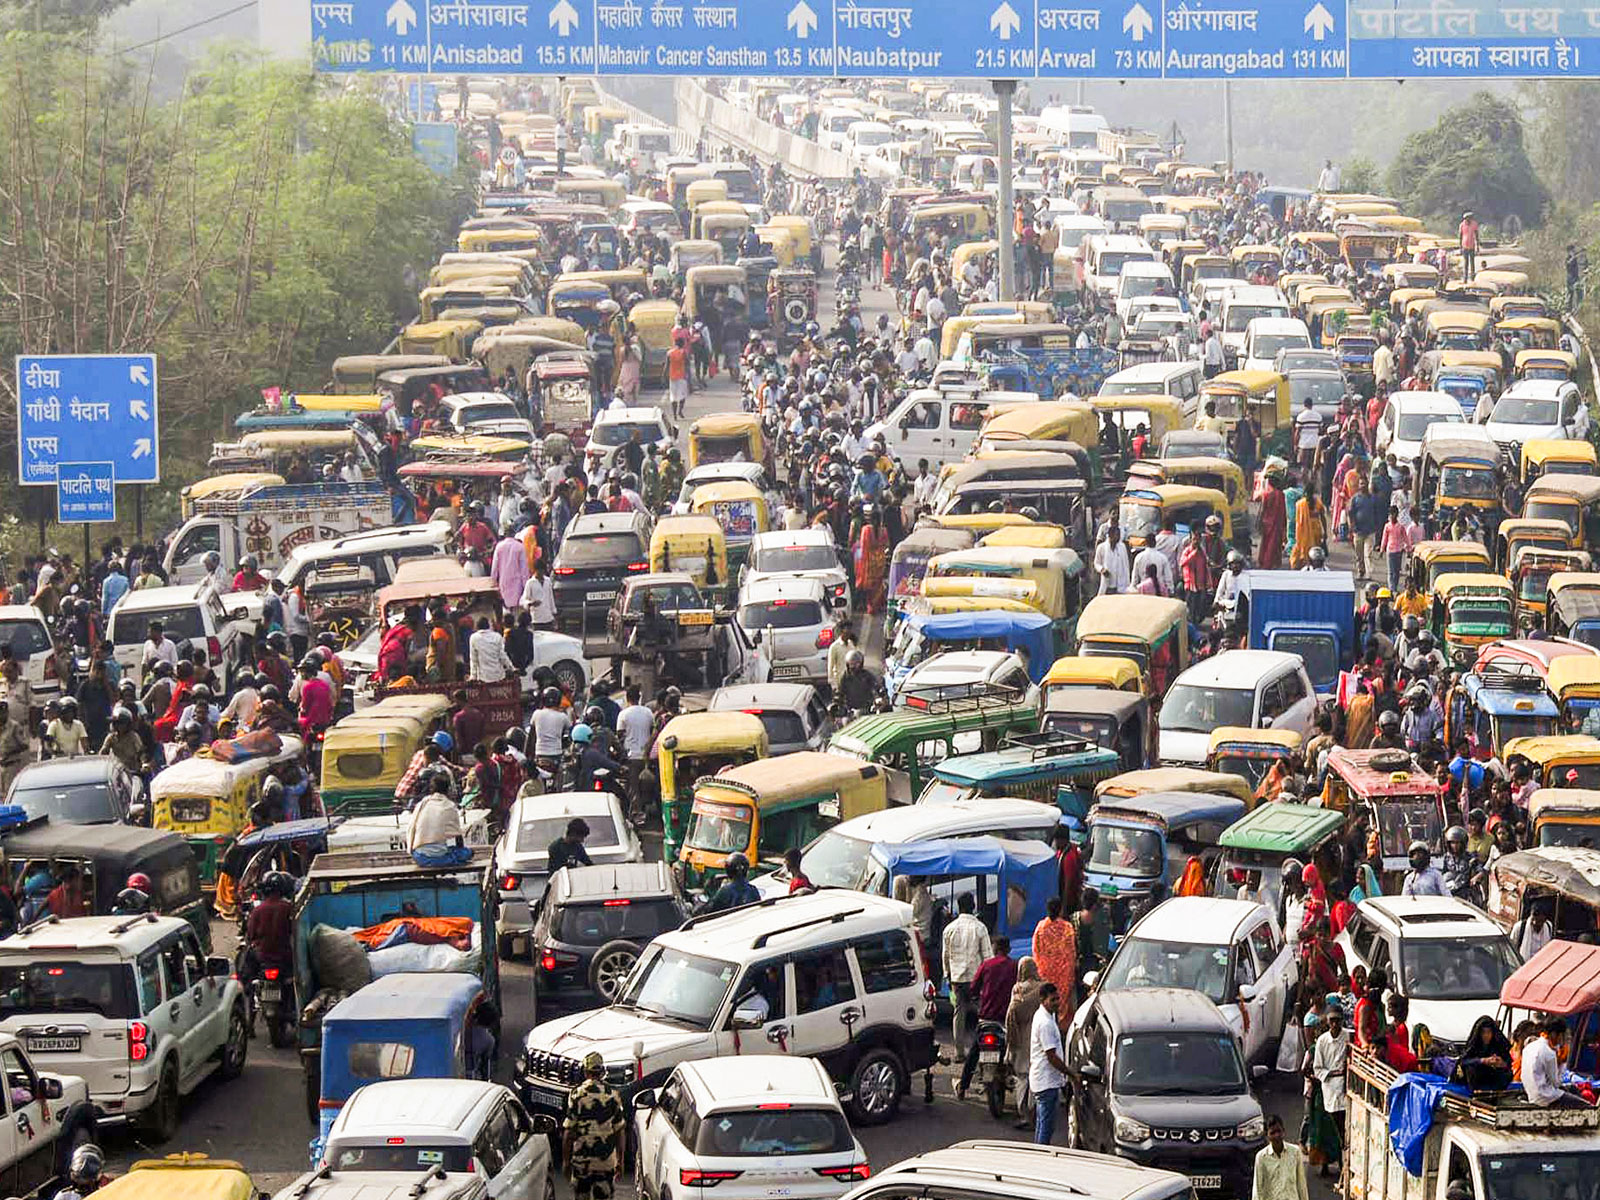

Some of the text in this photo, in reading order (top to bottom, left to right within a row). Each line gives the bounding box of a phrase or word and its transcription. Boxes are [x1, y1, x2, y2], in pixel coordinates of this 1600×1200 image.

[312, 3, 352, 28] एम्स
[430, 0, 528, 26] अनीसाबाद
[598, 0, 642, 29] महावीर
[1039, 9, 1100, 30] अरवल
[1166, 2, 1258, 31] औरंगाबाद
[1499, 8, 1564, 33] पथ
[381, 45, 395, 63] 11
[402, 45, 427, 63] KM
[432, 44, 593, 64] Anisabad 15.5 KM
[598, 45, 833, 66] Mahavir Cancer Sansthan 13.5 KM
[837, 46, 1034, 71] Naubatpur 21.5 KM
[1039, 48, 1161, 69] Arwal 73 KM
[1166, 49, 1345, 74] Aurangabad 131 KM
[1412, 46, 1482, 68] आपका
[1486, 46, 1550, 68] स्वागत
[25, 363, 60, 389] दीघा
[69, 396, 110, 421] मैदान
[26, 437, 58, 458] एम्स
[61, 473, 111, 495] पाटलि पथ
